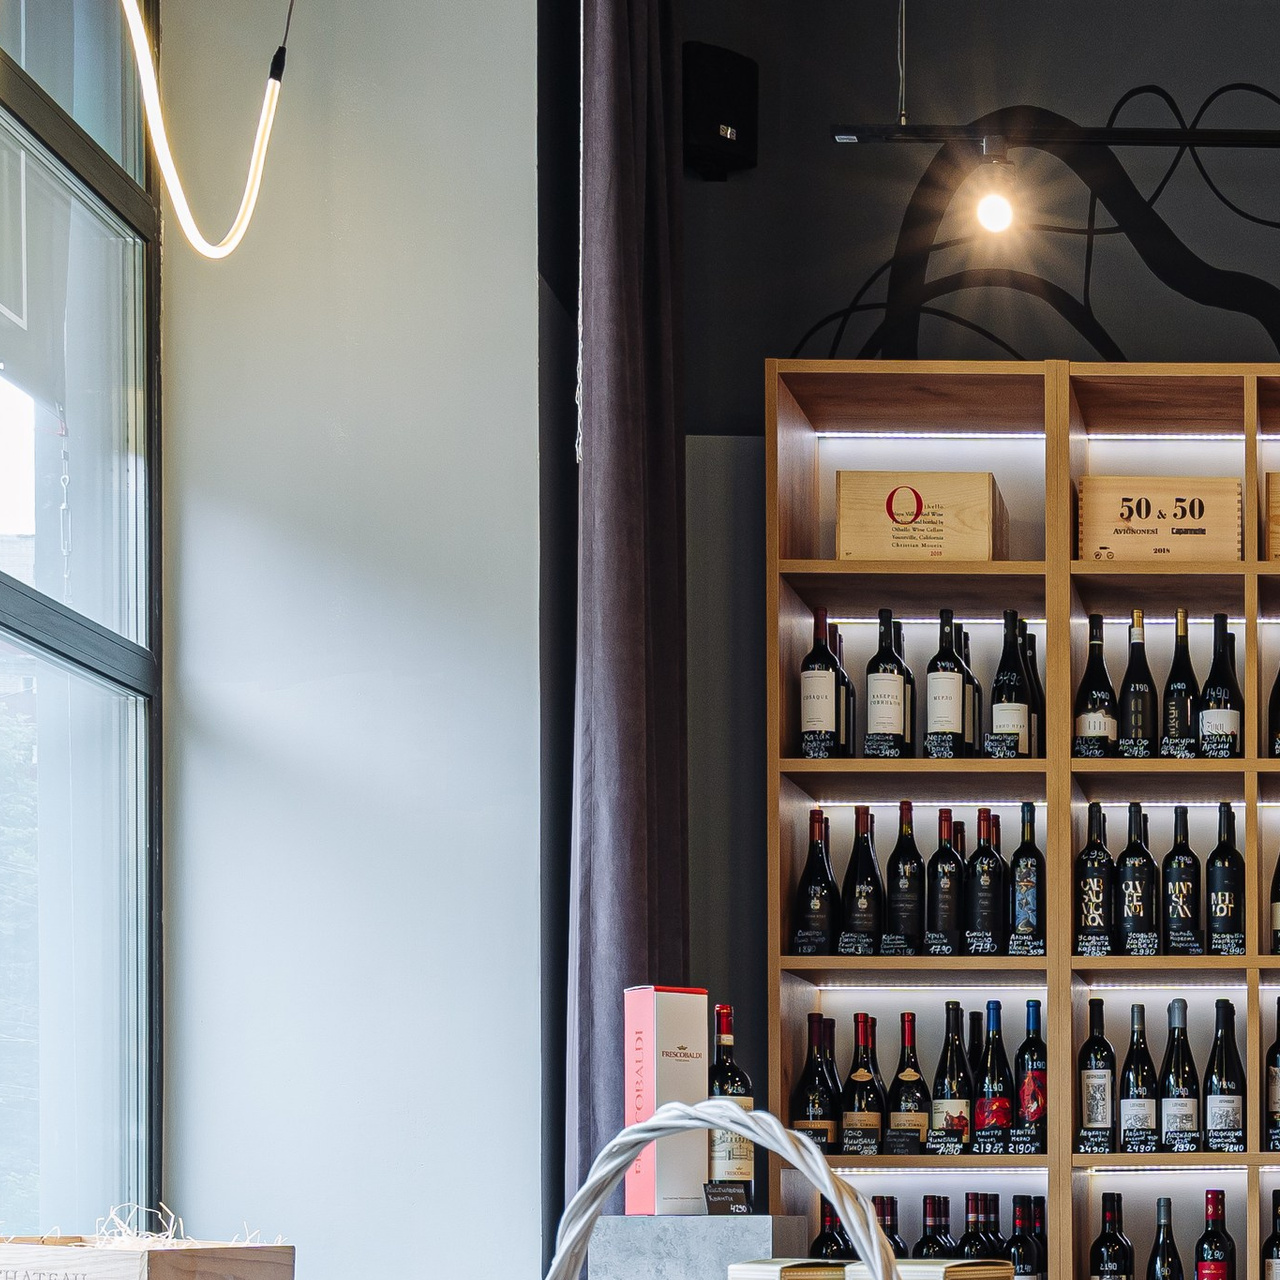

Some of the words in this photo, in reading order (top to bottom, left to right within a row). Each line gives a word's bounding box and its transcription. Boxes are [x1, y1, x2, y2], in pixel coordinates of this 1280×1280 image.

[1120, 497, 1151, 520] 50
[1157, 509, 1166, 519] &
[1173, 497, 1204, 520] 50
[879, 749, 900, 757] 3490
[992, 750, 1016, 758] 3490
[1205, 750, 1230, 758] 1490
[929, 945, 952, 954] 1790
[969, 944, 997, 953] 1790
[1220, 947, 1245, 955] 2990
[661, 1051, 702, 1059] FRESCOBALDI
[1172, 1144, 1196, 1152] 1990
[730, 1204, 747, 1213] 4290
